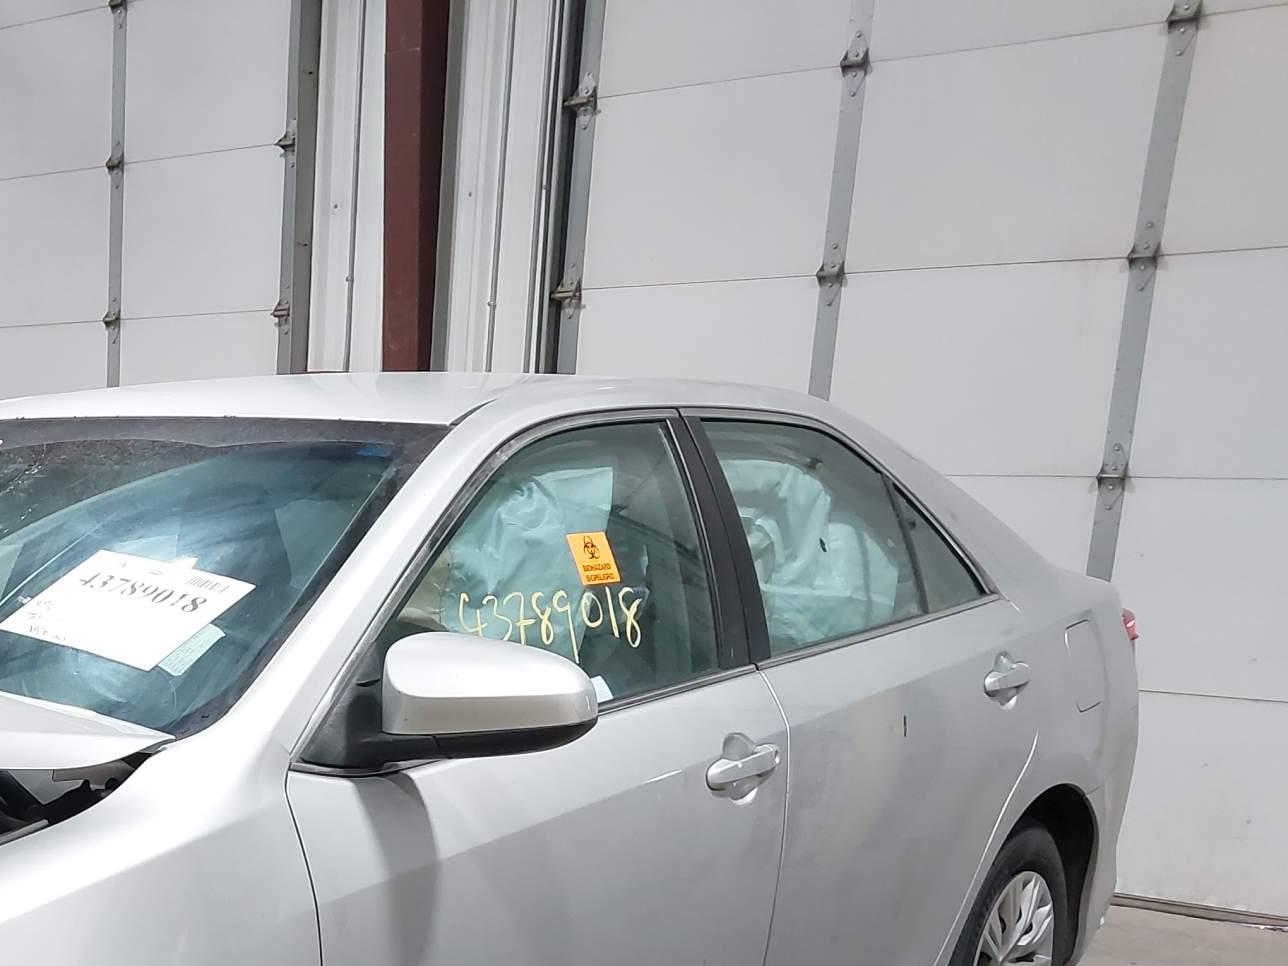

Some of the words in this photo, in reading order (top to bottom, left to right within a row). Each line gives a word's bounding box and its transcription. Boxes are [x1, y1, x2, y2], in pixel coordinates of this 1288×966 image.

[582, 562, 612, 572] BIOHAZARD
[79, 571, 207, 613] 43789018
[458, 586, 644, 664] 43789018
